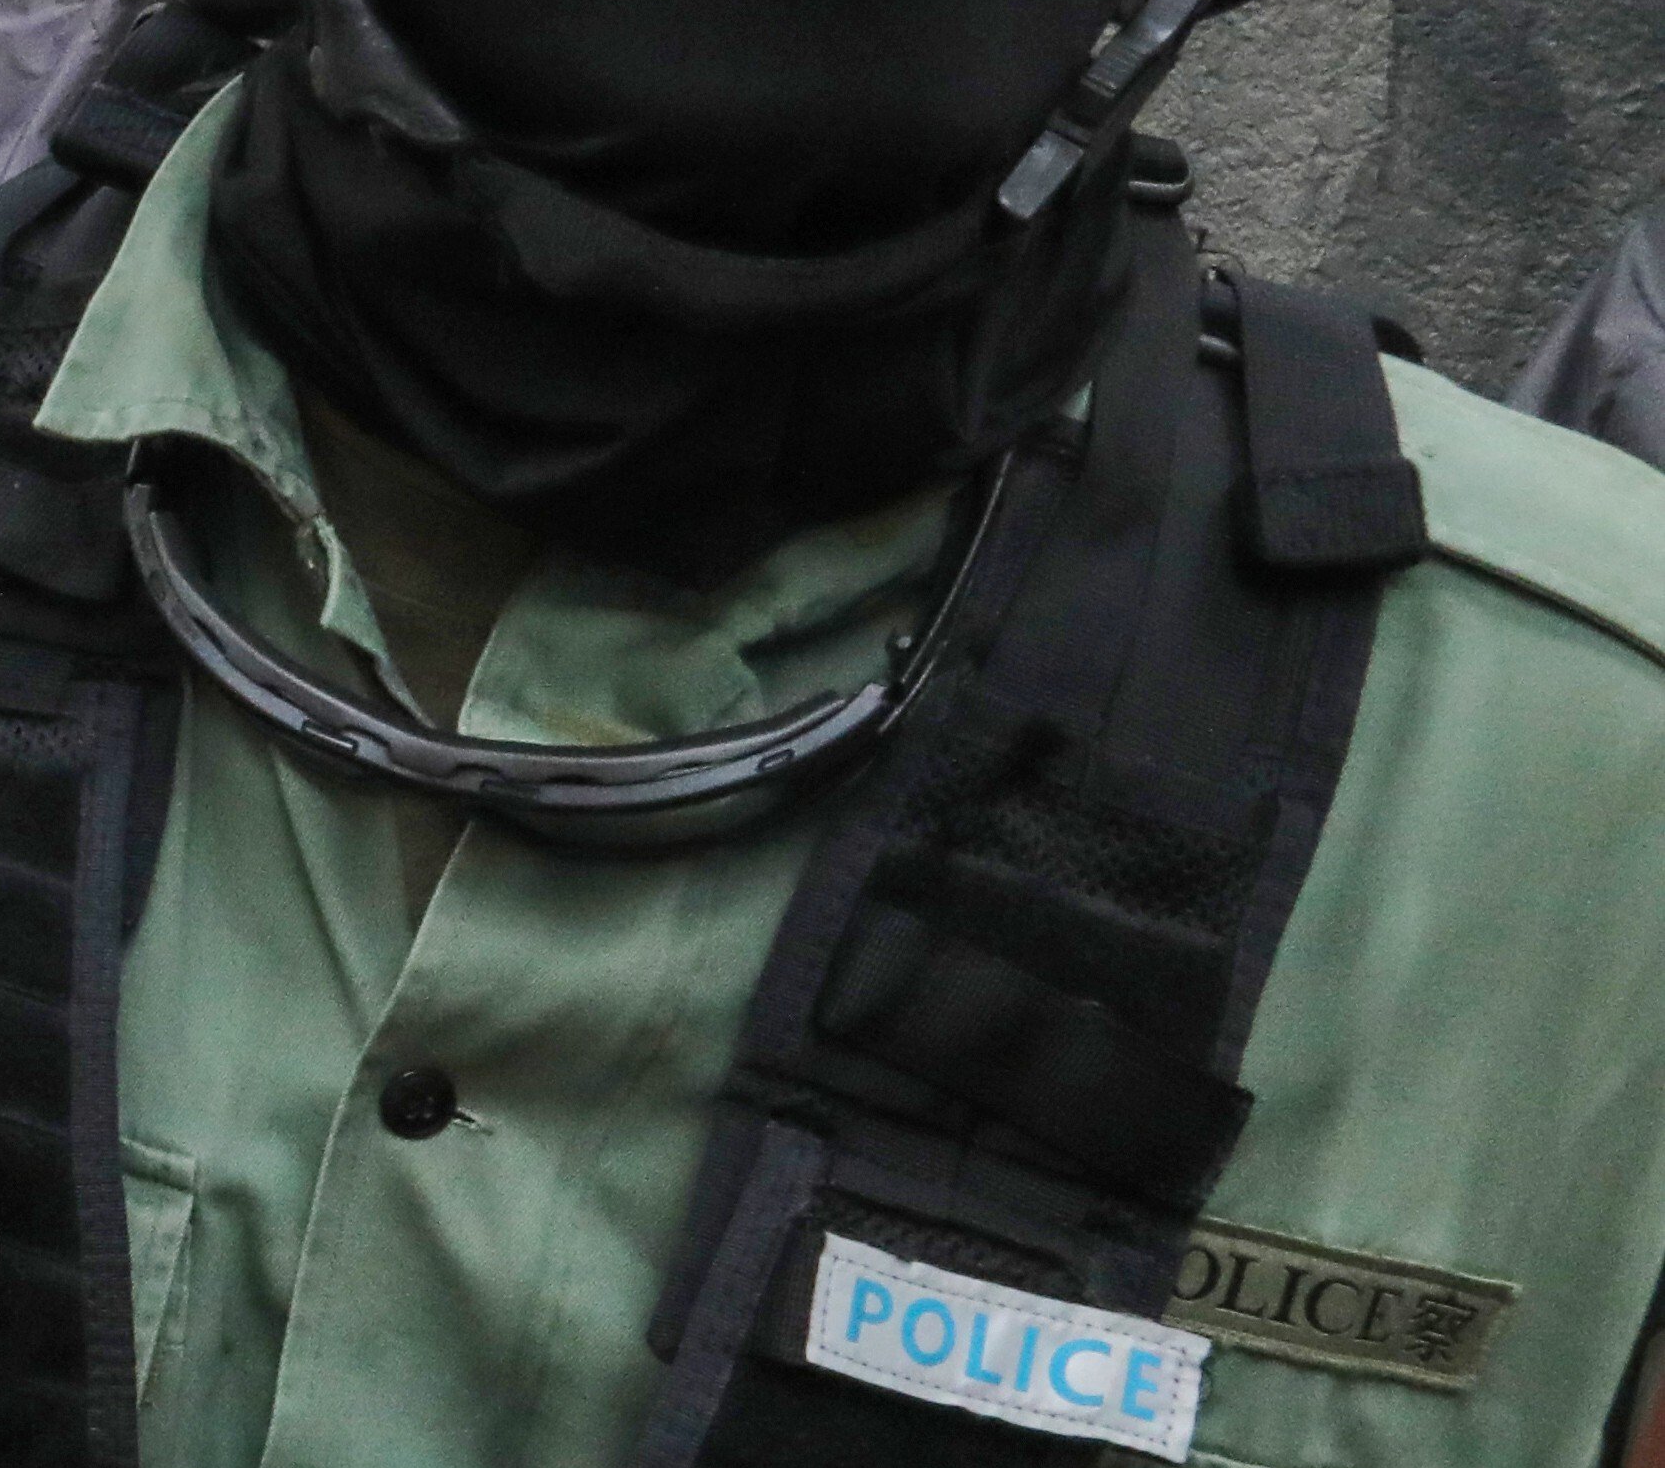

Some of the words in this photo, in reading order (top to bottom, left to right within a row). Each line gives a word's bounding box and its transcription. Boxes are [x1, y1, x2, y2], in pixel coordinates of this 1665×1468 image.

[844, 1275, 1168, 1425] POLICE
[1169, 1247, 1404, 1347] OLICE
[1406, 1290, 1477, 1366] 察
